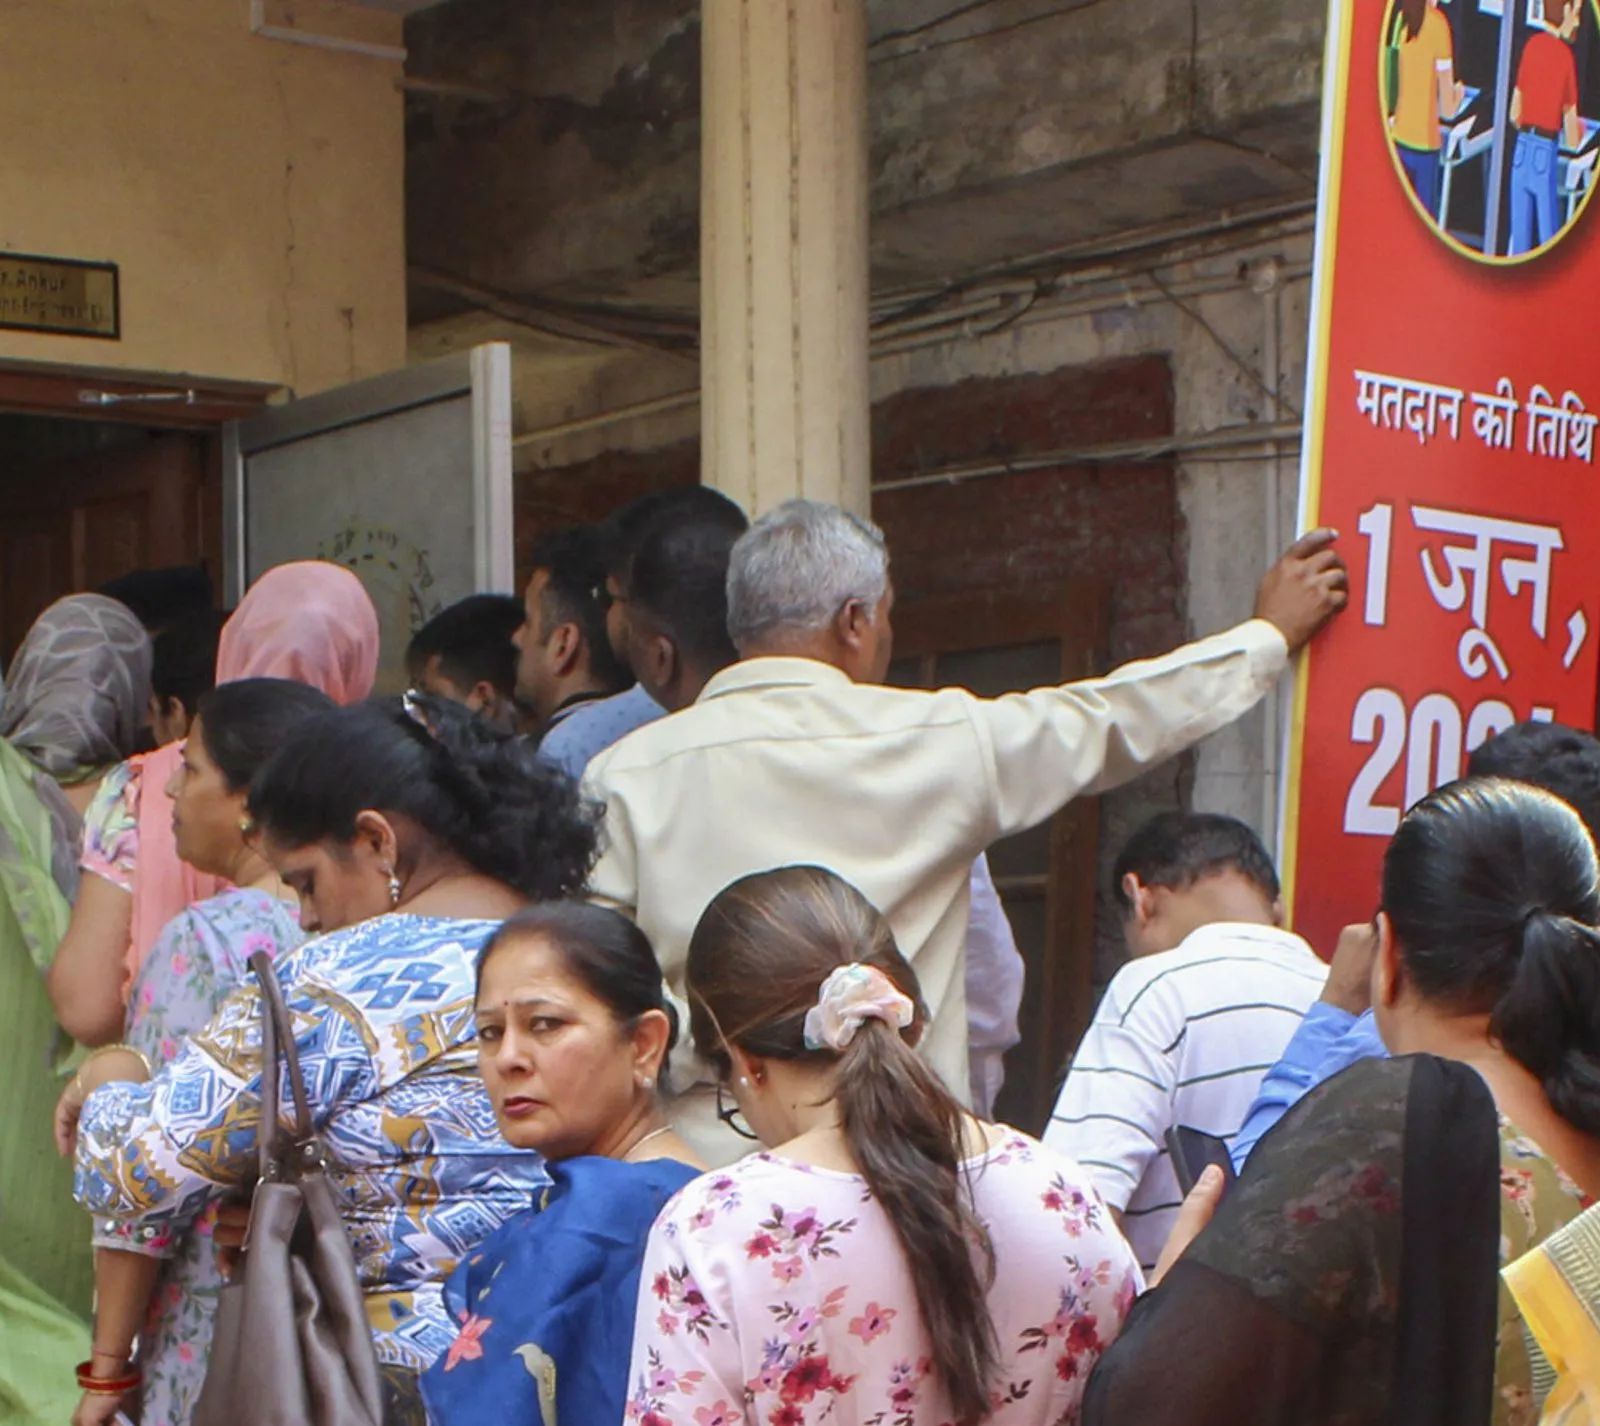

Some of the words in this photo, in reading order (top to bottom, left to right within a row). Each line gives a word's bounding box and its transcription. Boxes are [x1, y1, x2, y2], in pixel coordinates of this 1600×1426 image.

[1353, 369, 1464, 444] मतदान
[1470, 376, 1519, 449] की
[1526, 384, 1599, 463] तिथि
[1358, 503, 1392, 625] 1
[1343, 687, 1554, 836] 20
